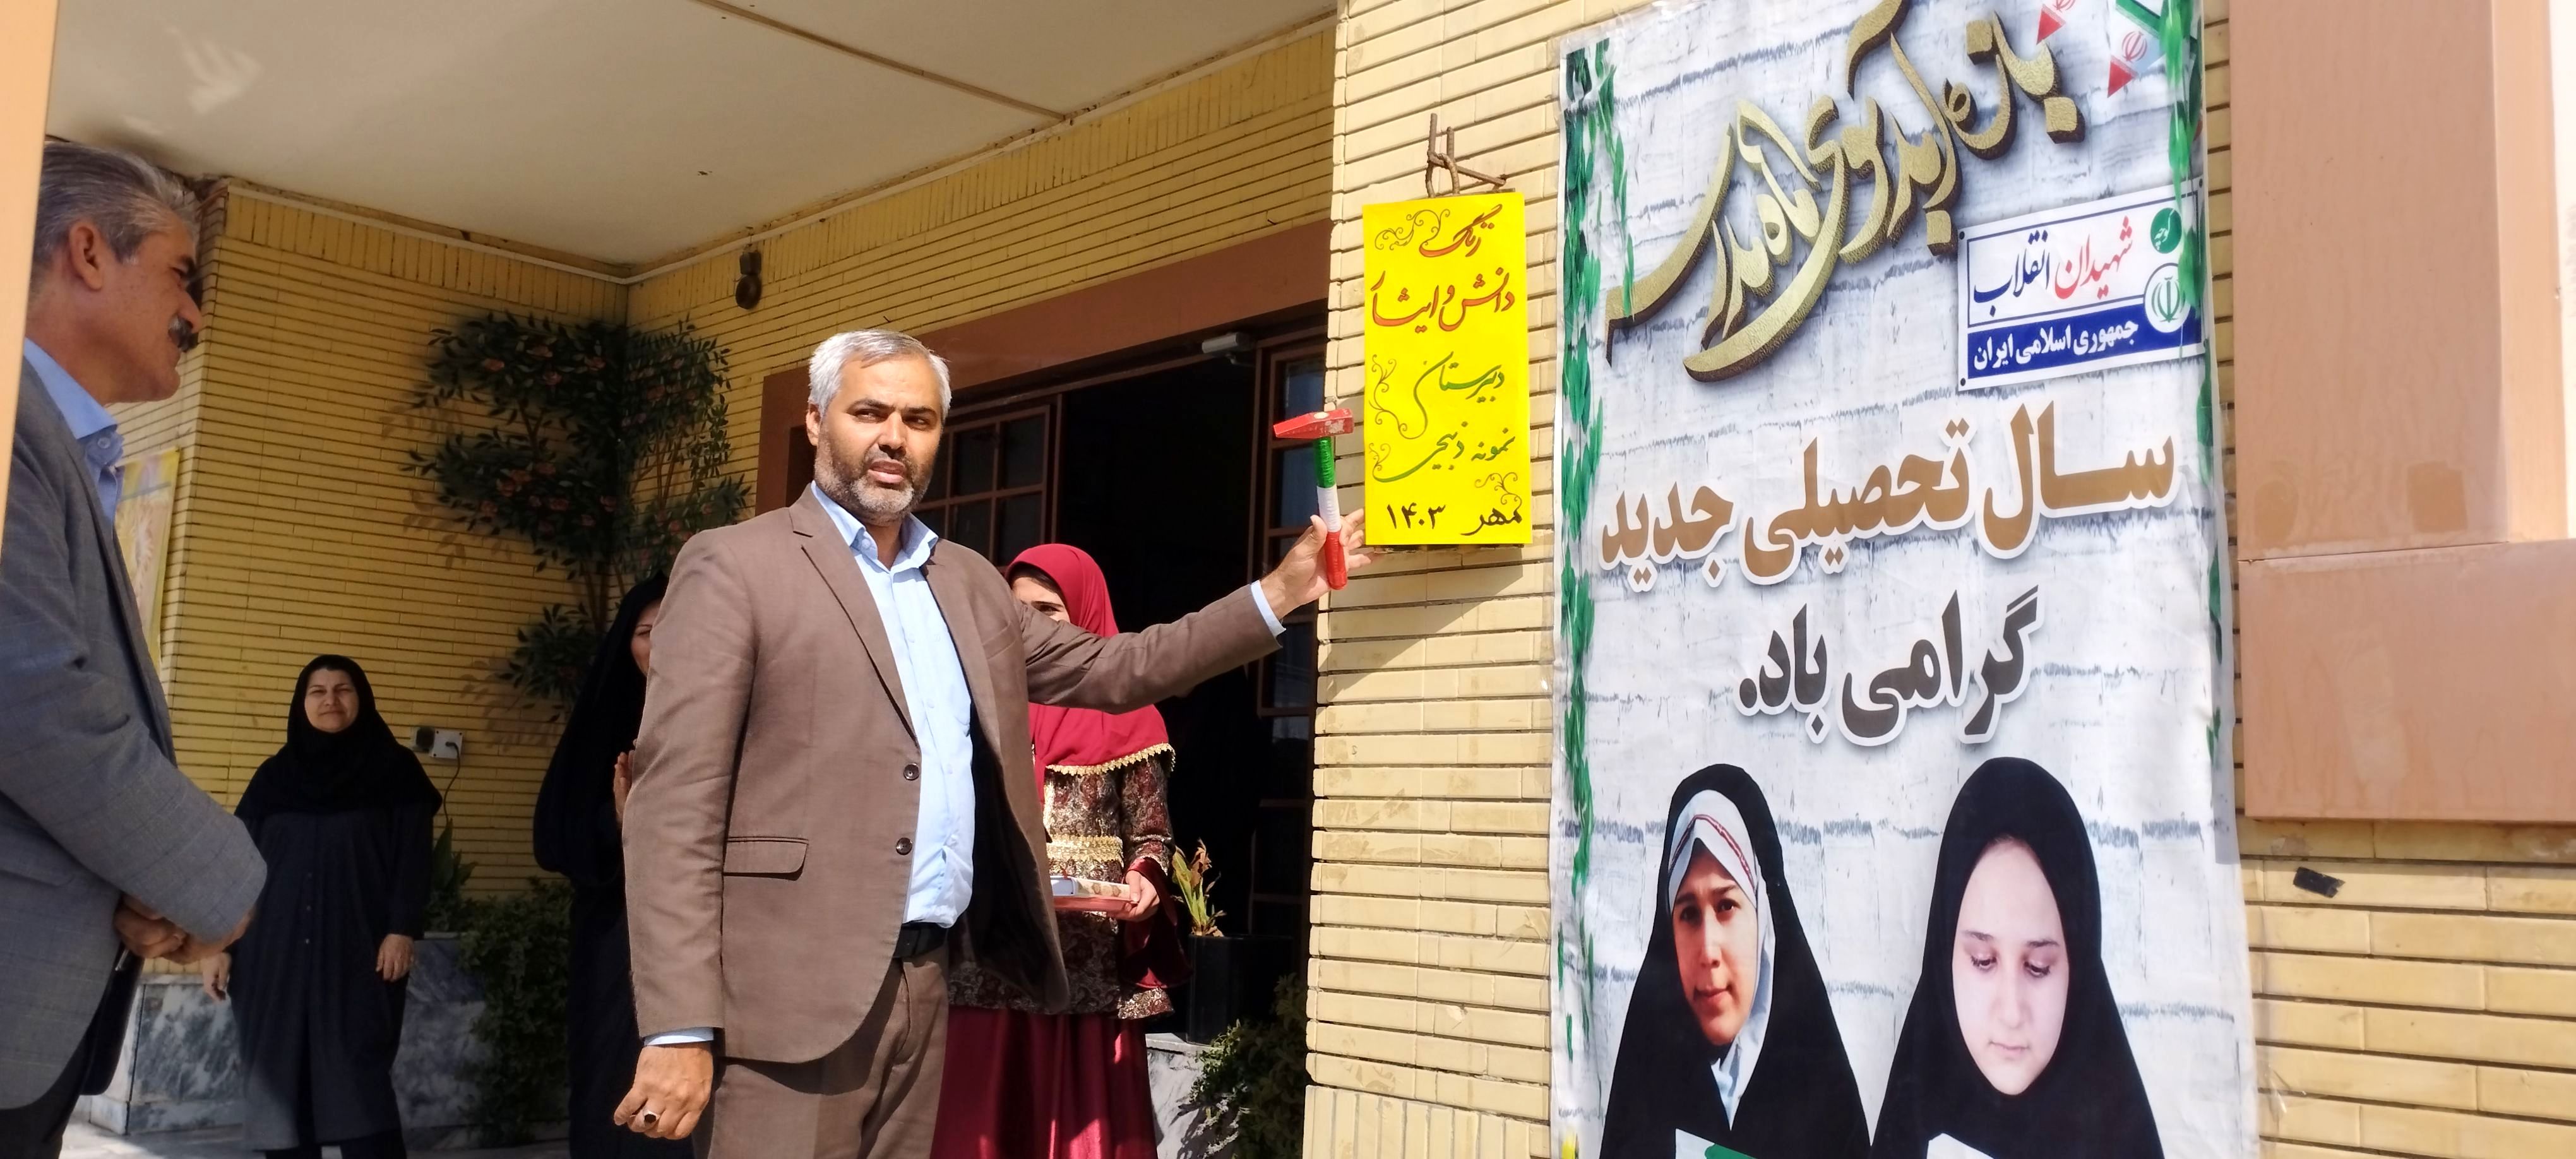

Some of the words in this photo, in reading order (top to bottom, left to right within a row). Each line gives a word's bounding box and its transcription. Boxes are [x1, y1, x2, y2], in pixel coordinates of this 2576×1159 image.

[1419, 203, 1503, 258] زنگ
[2054, 215, 2133, 300] شهیدان
[1370, 270, 1440, 333] ایثار
[1438, 266, 1515, 332] دانش
[1442, 285, 1455, 305] و
[1973, 230, 2051, 318] انقلاب
[1974, 333, 2013, 370] ایران
[2016, 324, 2072, 364] اسلامی
[2073, 319, 2139, 355] جمهوری
[1413, 351, 1505, 436] دبیرستان
[1373, 420, 1469, 483] ذبیحی
[1471, 427, 1515, 461] نمونه
[1983, 400, 2174, 550] سال
[1386, 502, 1446, 530] ۱۴۰۳
[1460, 508, 1523, 536] مهر
[1744, 418, 1970, 578] تحصیلی
[1601, 481, 1734, 586] جدید
[1738, 602, 1827, 736] باد.
[1842, 584, 2039, 738] گرامی
